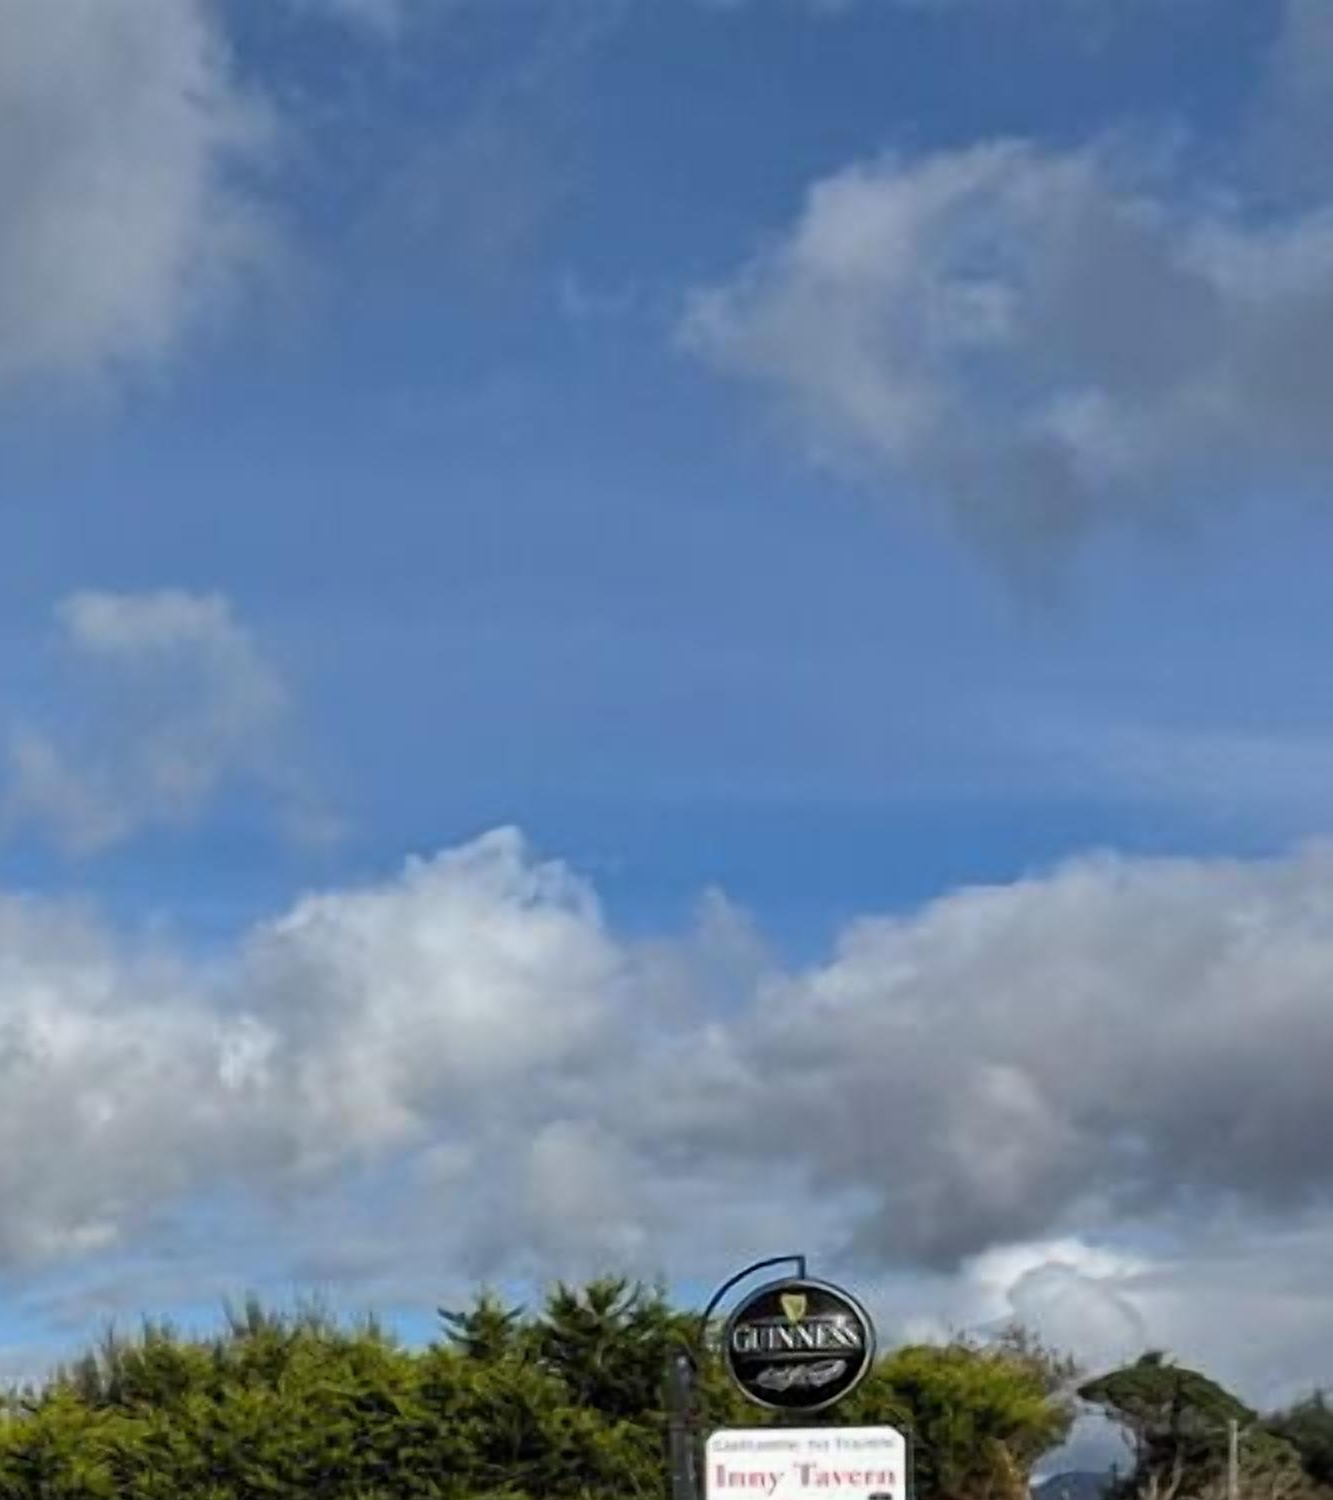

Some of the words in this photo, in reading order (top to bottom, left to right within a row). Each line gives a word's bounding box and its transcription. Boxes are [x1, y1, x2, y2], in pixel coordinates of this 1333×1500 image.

[733, 1324, 861, 1352] GUINNESS
[716, 1464, 784, 1496] Inny
[794, 1462, 896, 1487] Tavern
